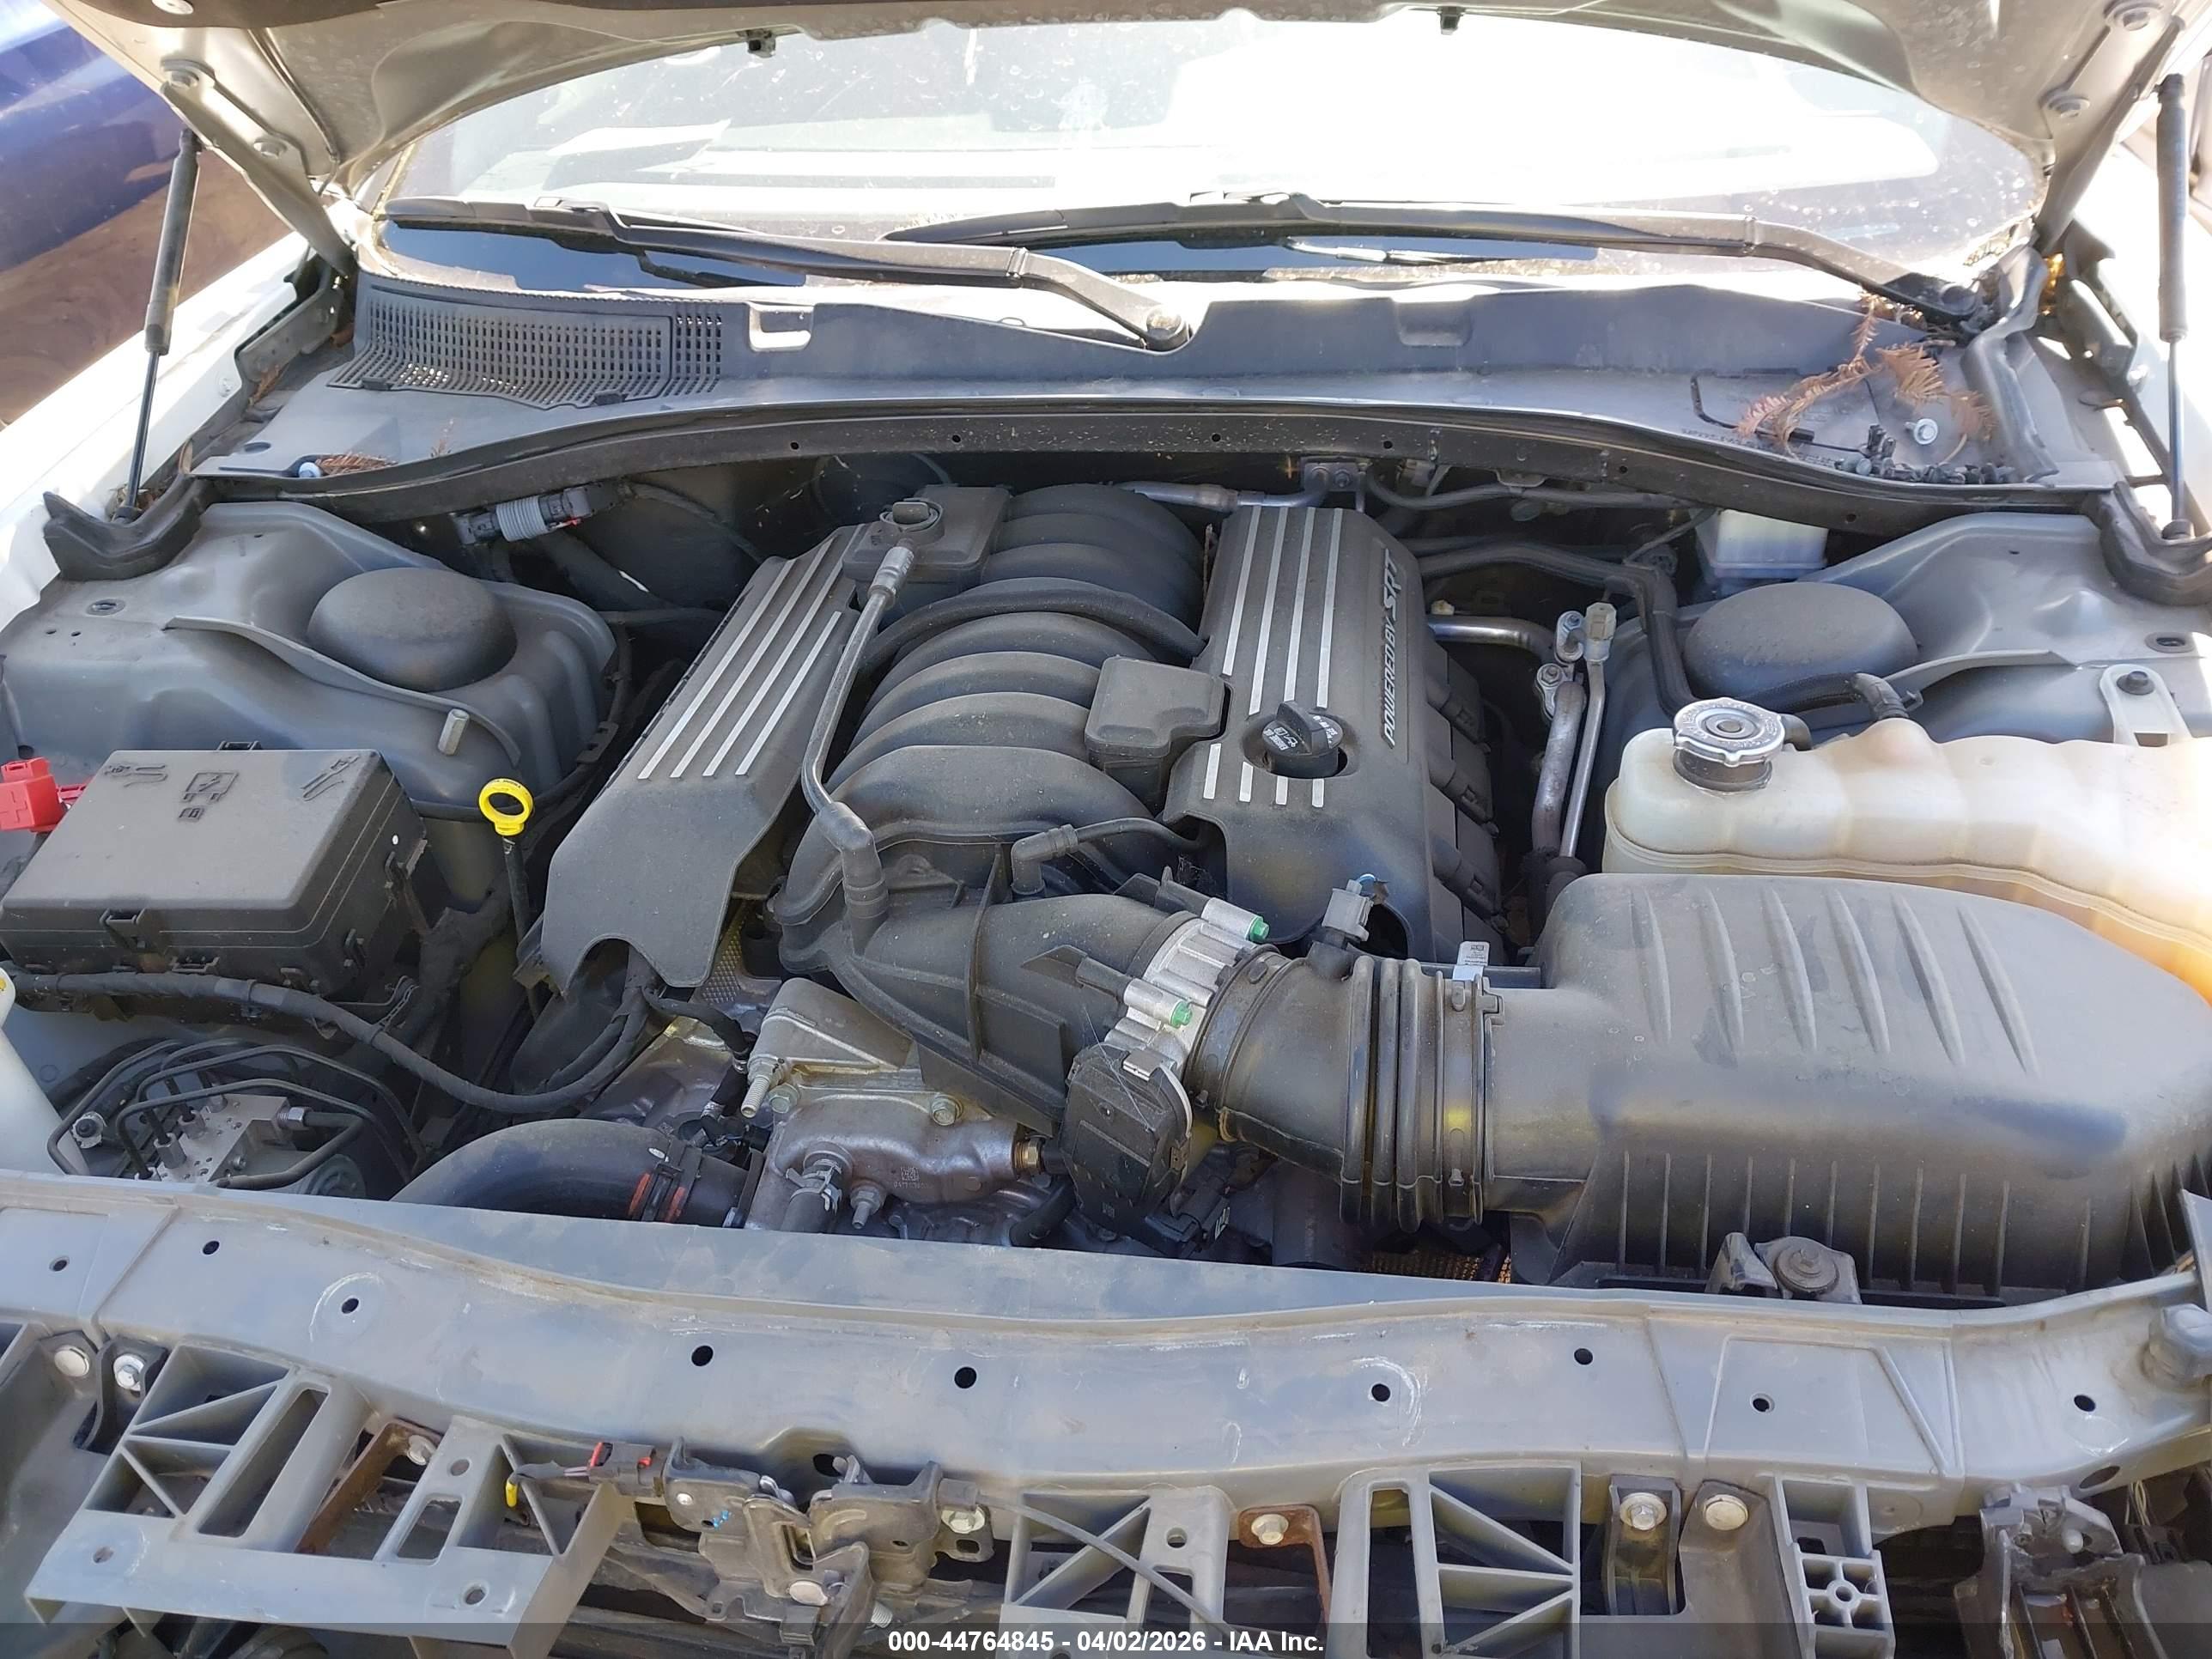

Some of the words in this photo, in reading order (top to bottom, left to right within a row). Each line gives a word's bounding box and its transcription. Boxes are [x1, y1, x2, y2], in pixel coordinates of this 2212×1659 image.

[1383, 548, 1401, 621] SRT
[1385, 617, 1395, 642] BY
[1384, 643, 1395, 746] POWERED
